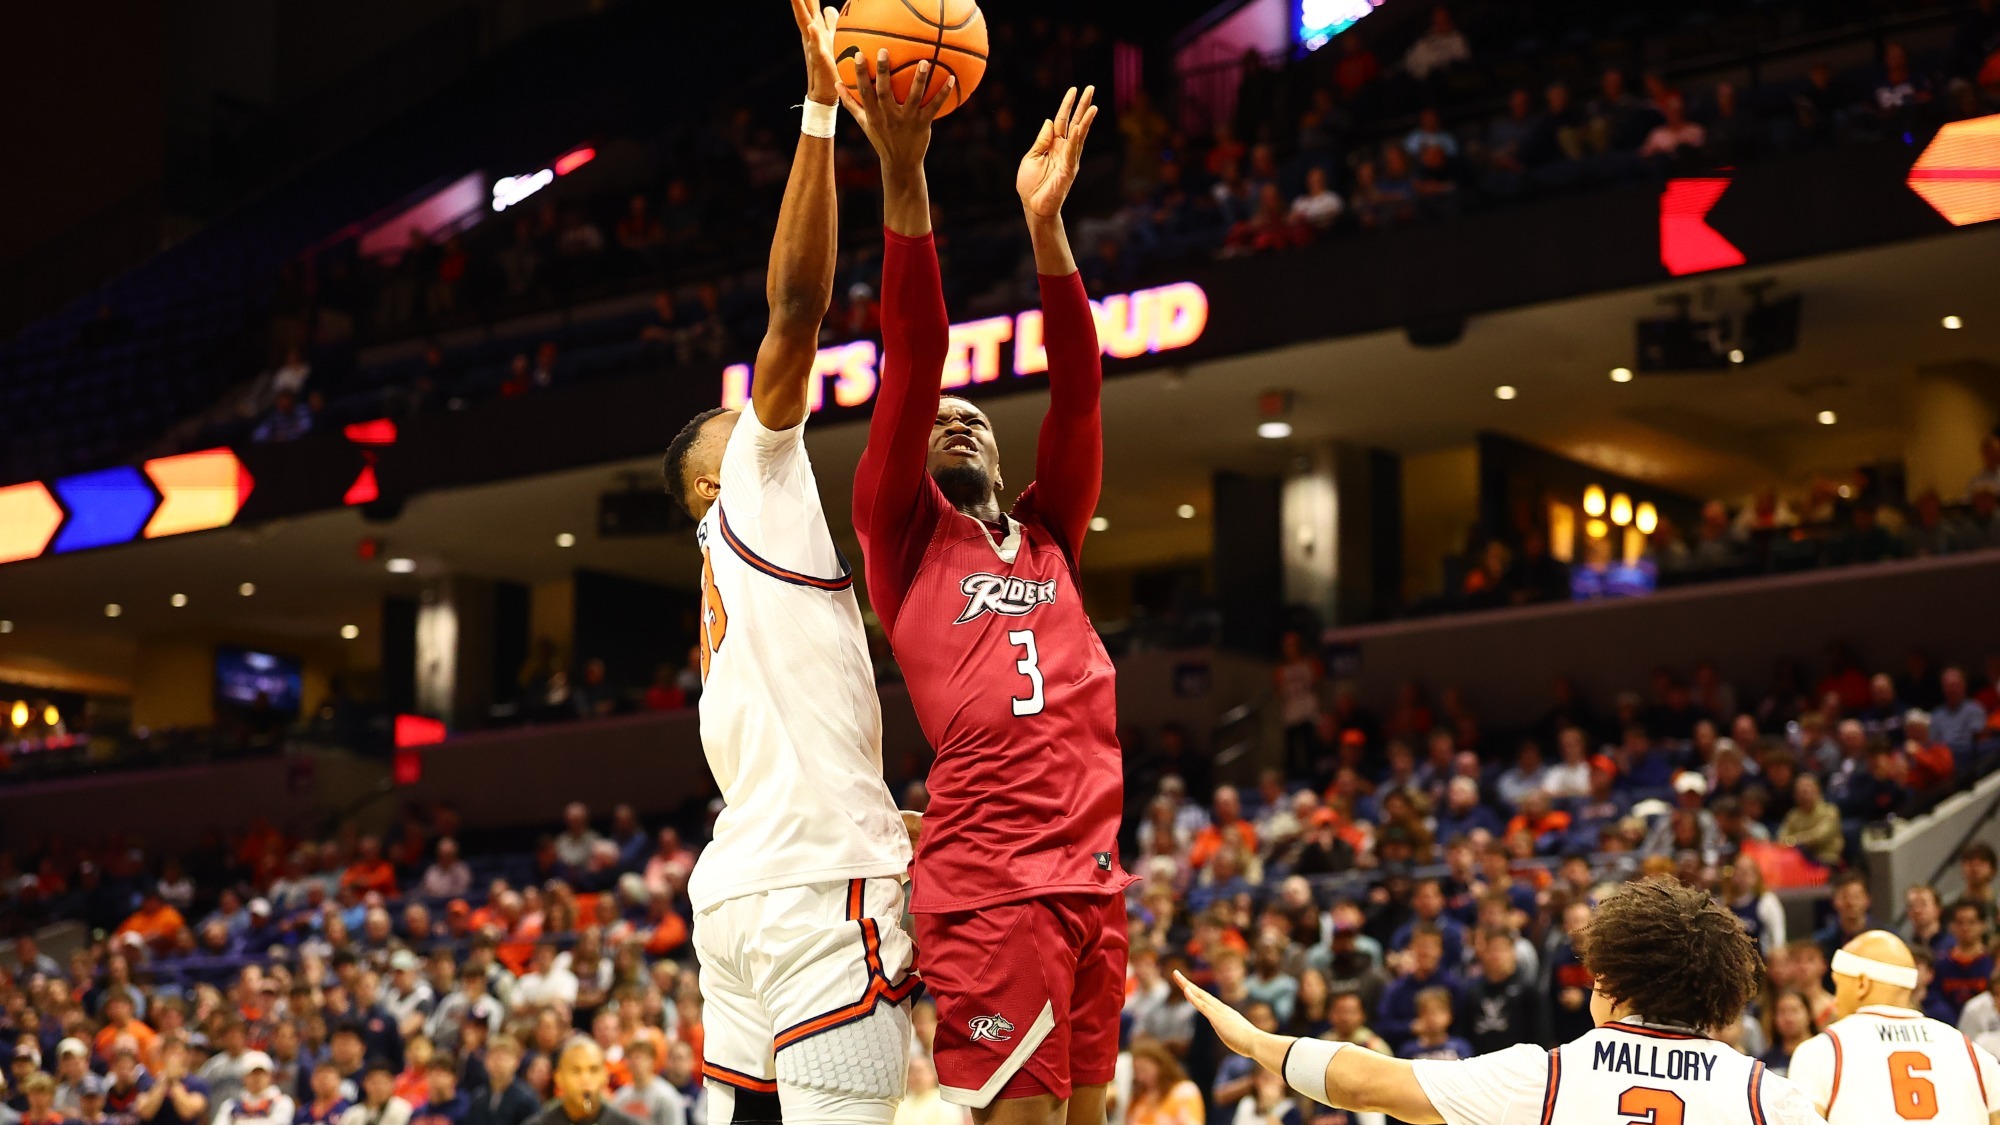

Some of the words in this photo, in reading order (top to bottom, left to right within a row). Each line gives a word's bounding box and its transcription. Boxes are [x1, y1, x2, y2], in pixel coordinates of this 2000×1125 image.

[721, 339, 877, 413] LT'S
[880, 315, 1013, 390] ET
[1013, 281, 1209, 377] LUD
[1008, 628, 1045, 718] 3
[1592, 1040, 1718, 1082] MALLORY
[1874, 1024, 1934, 1043] WHITE
[1887, 1051, 1939, 1121] 6
